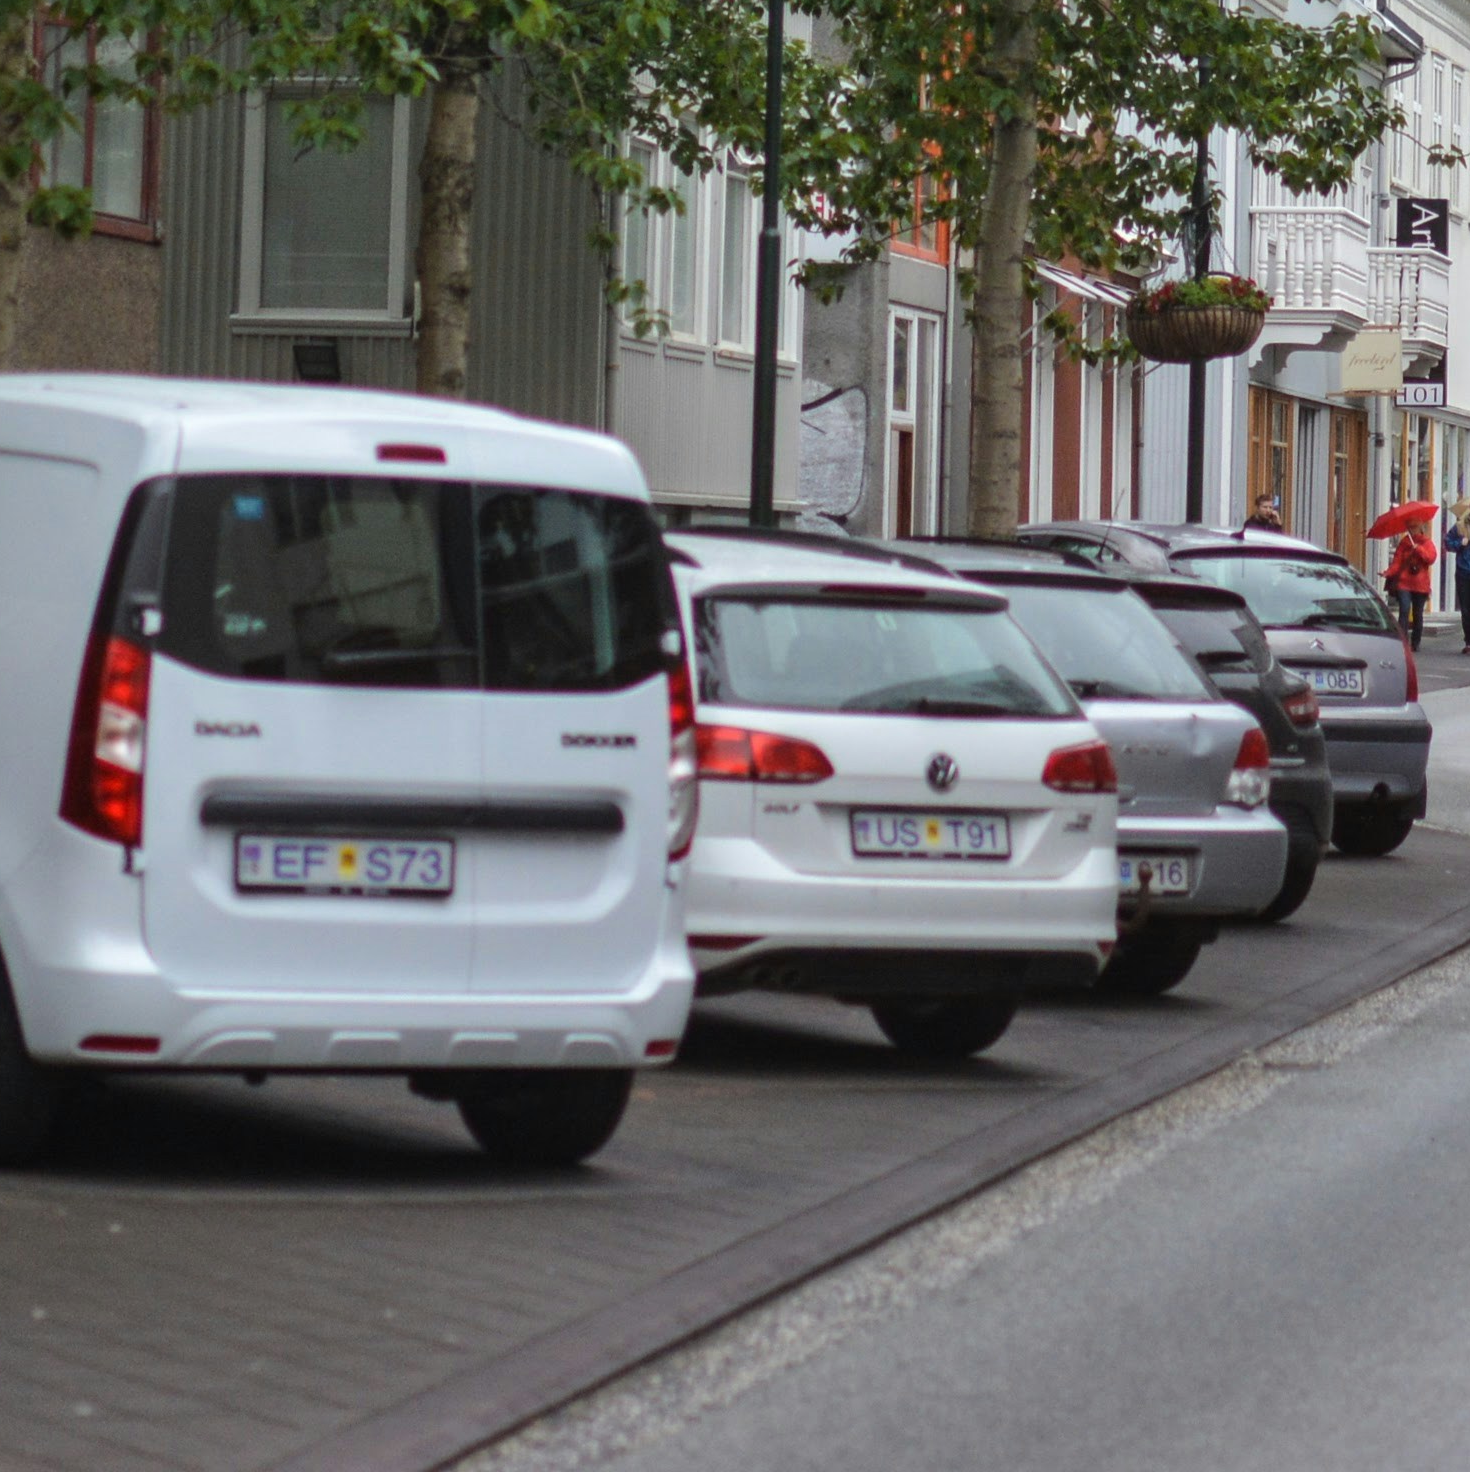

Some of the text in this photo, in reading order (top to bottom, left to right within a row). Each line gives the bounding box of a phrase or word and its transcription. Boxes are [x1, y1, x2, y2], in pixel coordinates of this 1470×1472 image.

[877, 817, 997, 849] US T91
[273, 843, 443, 884] EF S73
